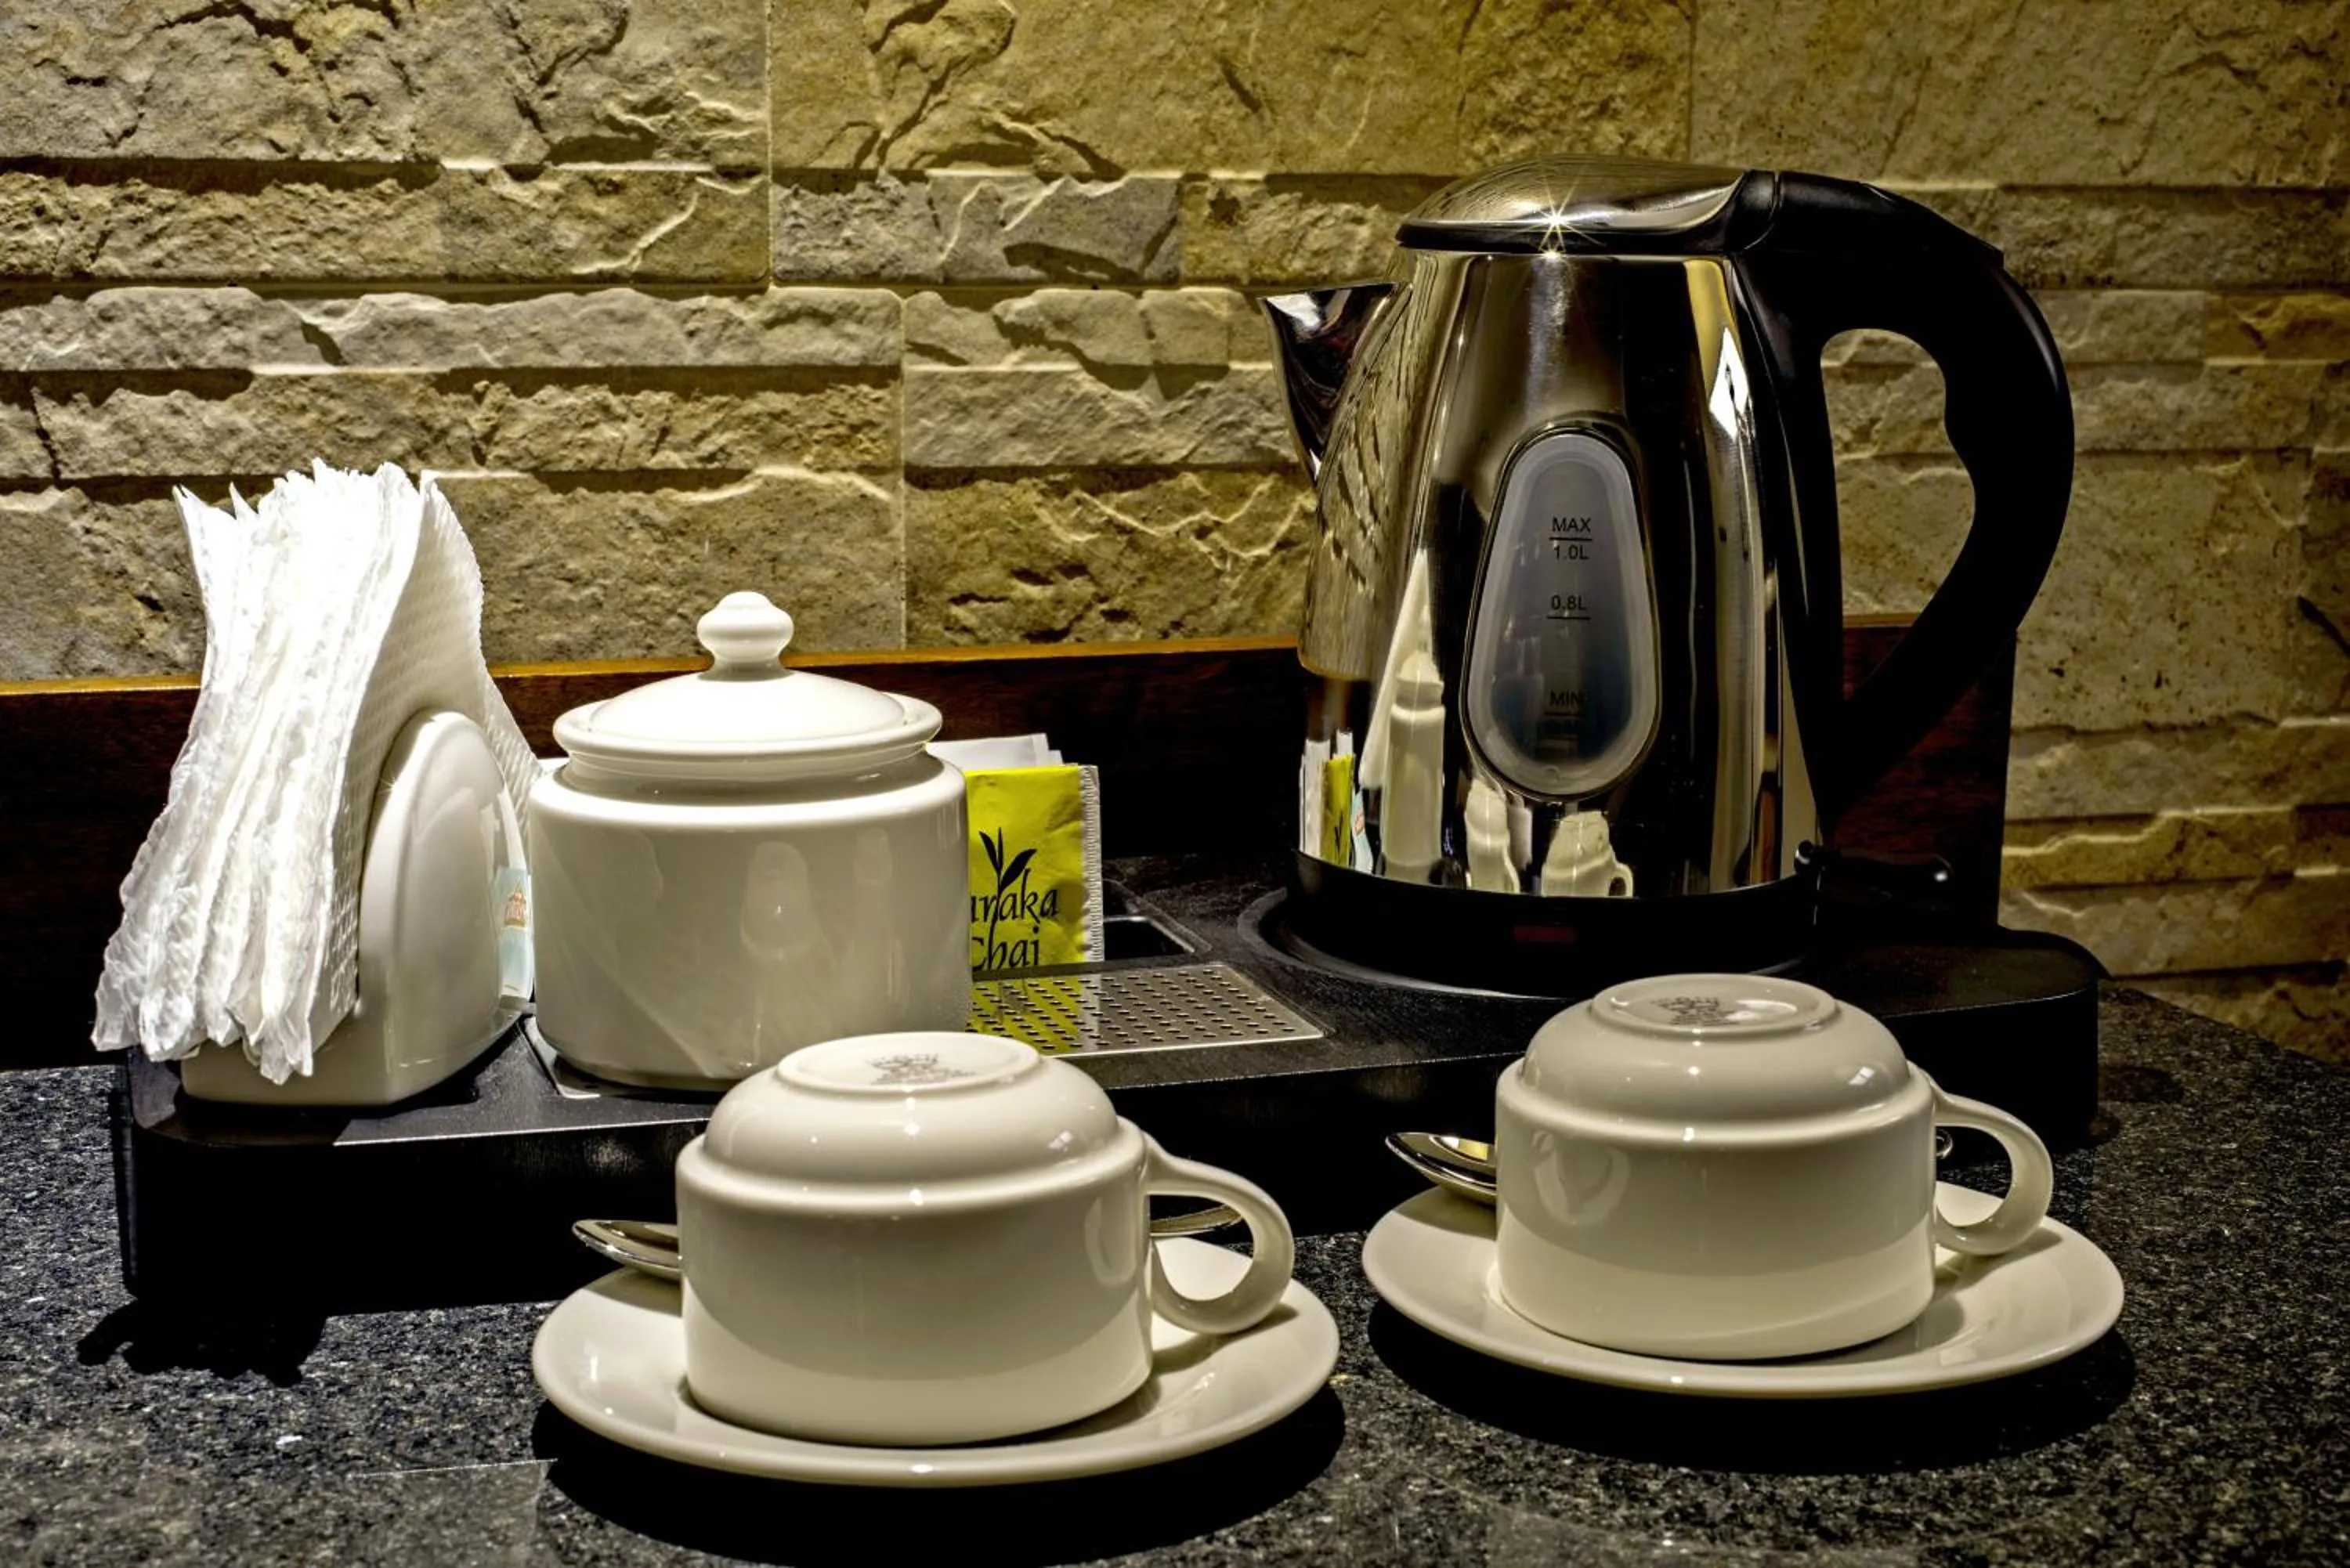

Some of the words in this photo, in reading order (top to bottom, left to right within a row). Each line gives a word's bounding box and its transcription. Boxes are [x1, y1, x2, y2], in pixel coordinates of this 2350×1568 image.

[1552, 516, 1591, 533] MAX
[1553, 544, 1589, 560] 1.0L
[1550, 594, 1587, 611] 0.8L
[1549, 690, 1584, 706] MIN
